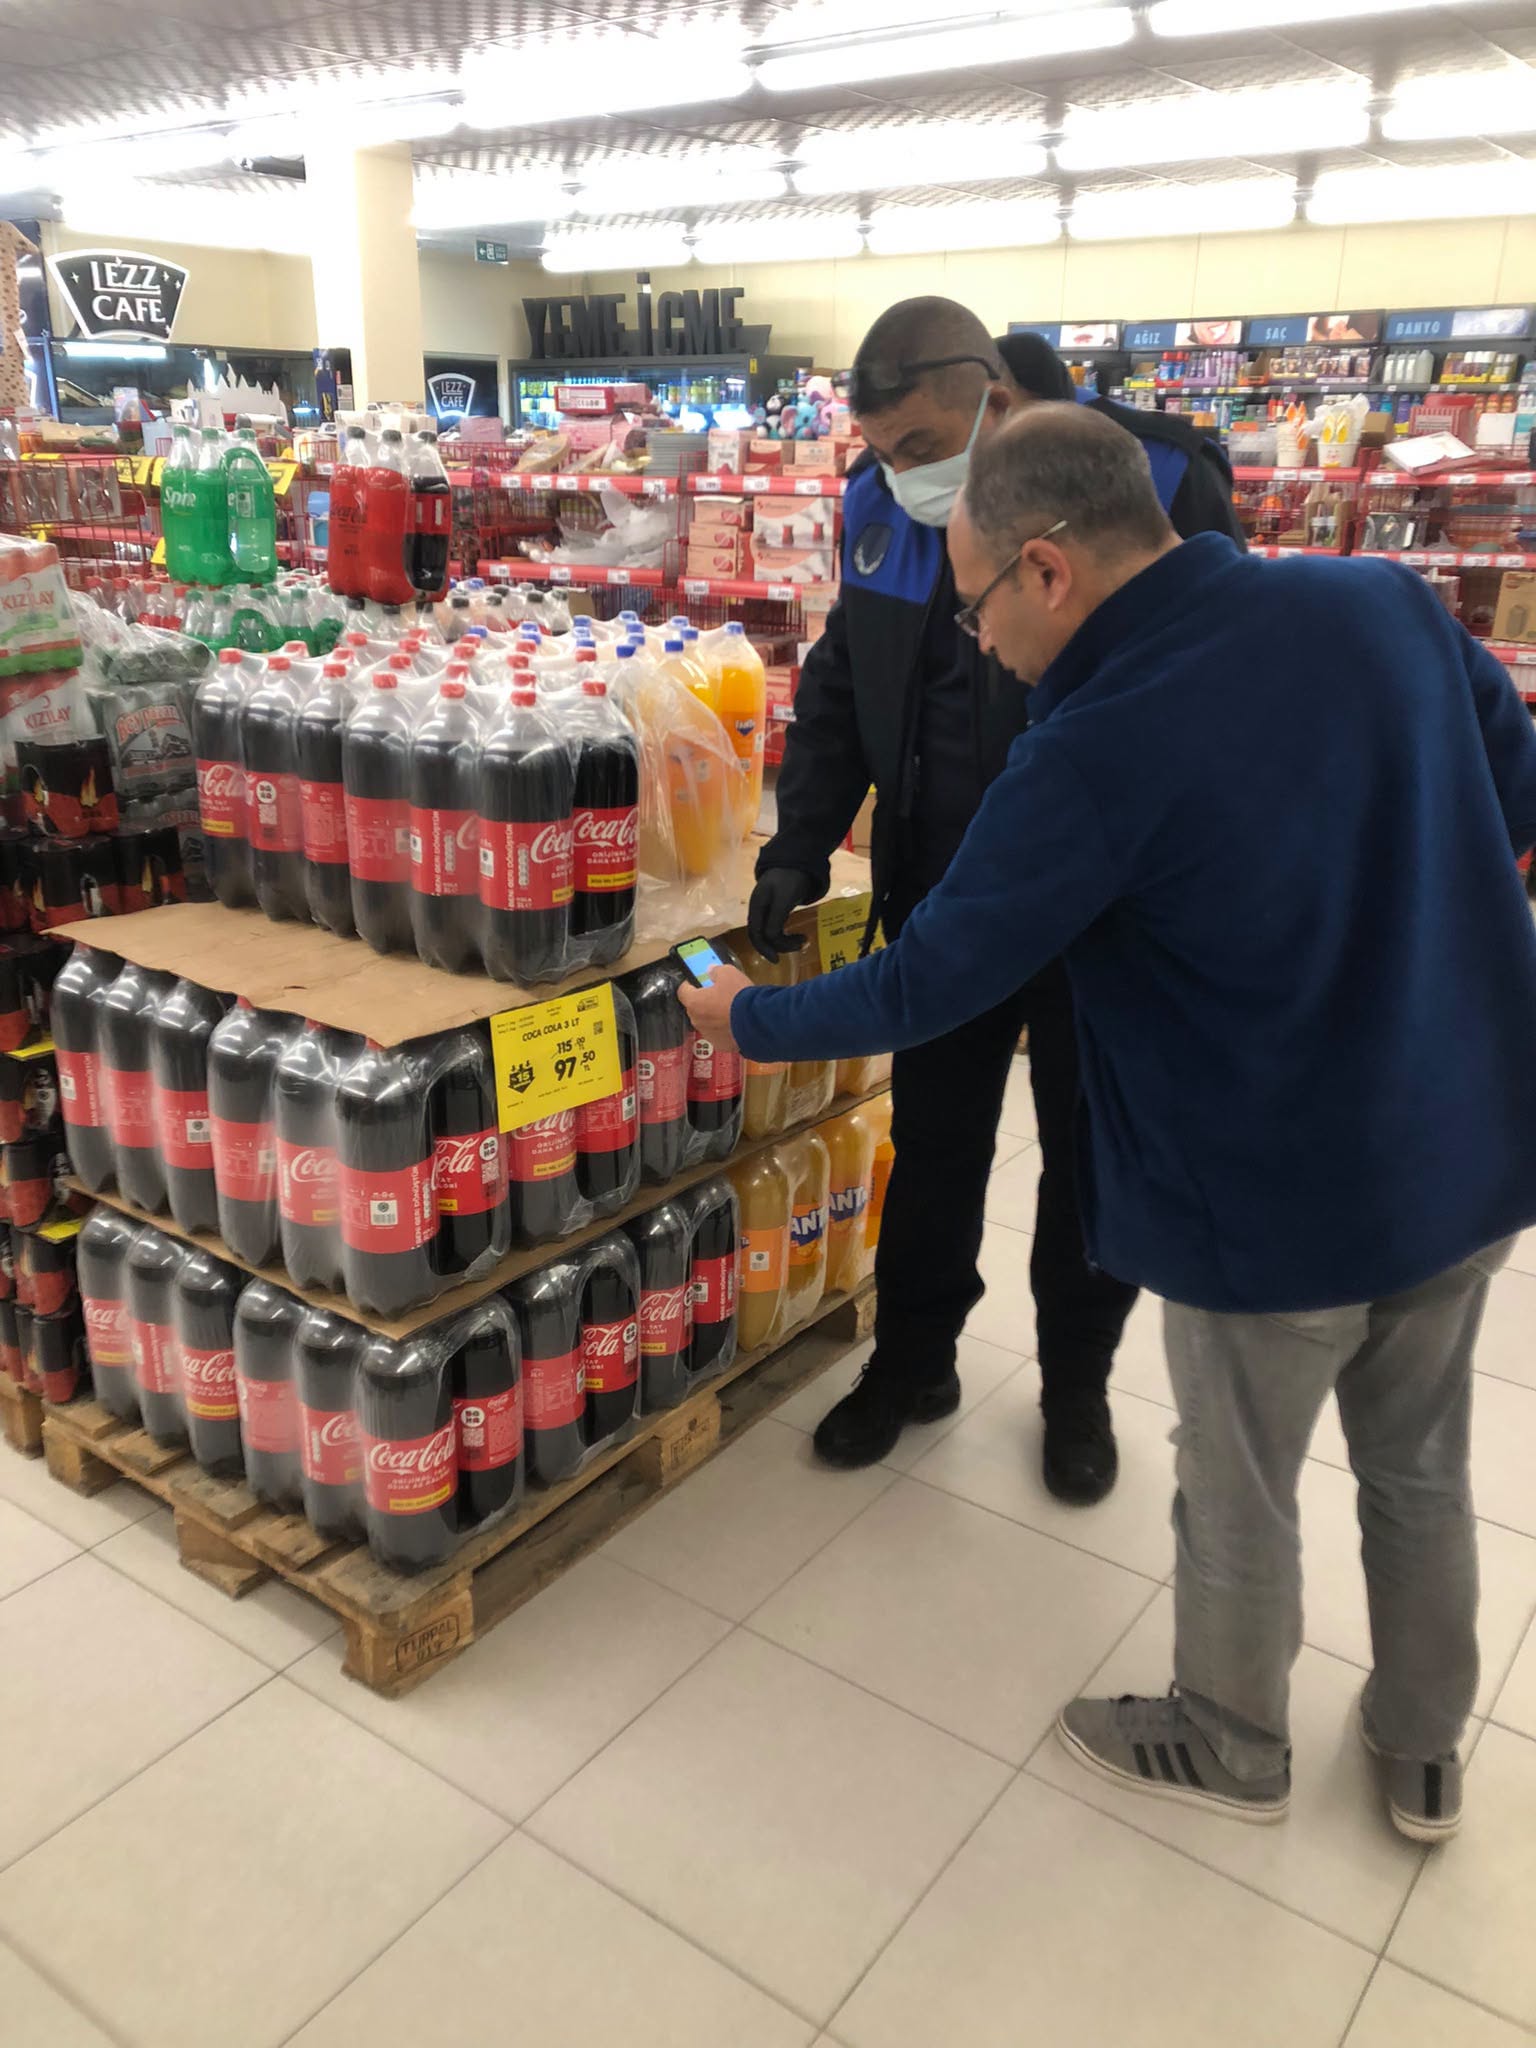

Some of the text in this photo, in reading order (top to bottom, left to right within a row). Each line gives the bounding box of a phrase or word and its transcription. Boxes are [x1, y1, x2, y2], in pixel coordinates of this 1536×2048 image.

[90, 260, 161, 295] LEZZ
[92, 295, 166, 323] CAFE
[521, 292, 626, 359] YEME
[1395, 320, 1441, 336] BANYO
[441, 380, 463, 396] LEZZ
[441, 395, 464, 408] CAFE
[24, 706, 71, 730] KIZILAY
[522, 1029, 542, 1042] COCA
[543, 1022, 562, 1035] COLA
[564, 1020, 570, 1029] 3
[572, 1018, 580, 1027] LT
[557, 1040, 573, 1055] 115
[554, 1056, 577, 1081] 97
